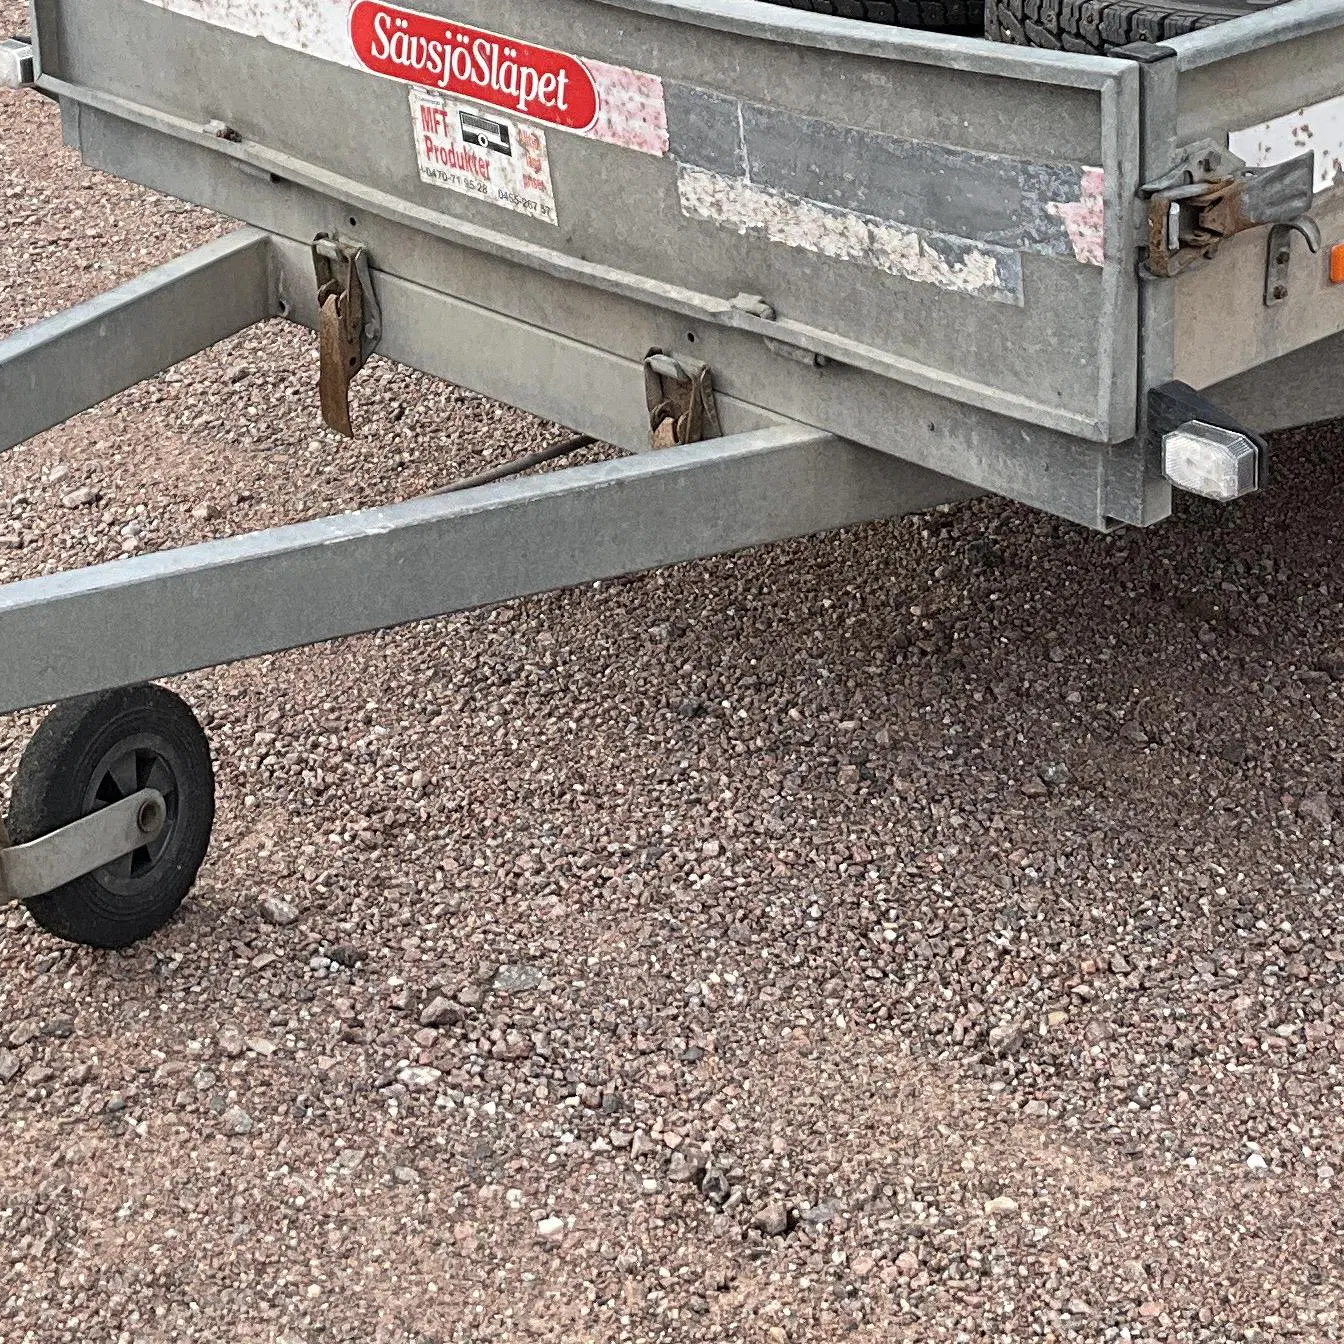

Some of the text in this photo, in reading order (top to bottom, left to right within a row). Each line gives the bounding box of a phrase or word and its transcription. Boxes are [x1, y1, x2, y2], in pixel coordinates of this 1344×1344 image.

[371, 12, 570, 111] SävsjöSläpet
[420, 104, 448, 137] MFT
[424, 135, 490, 181] Produkter
